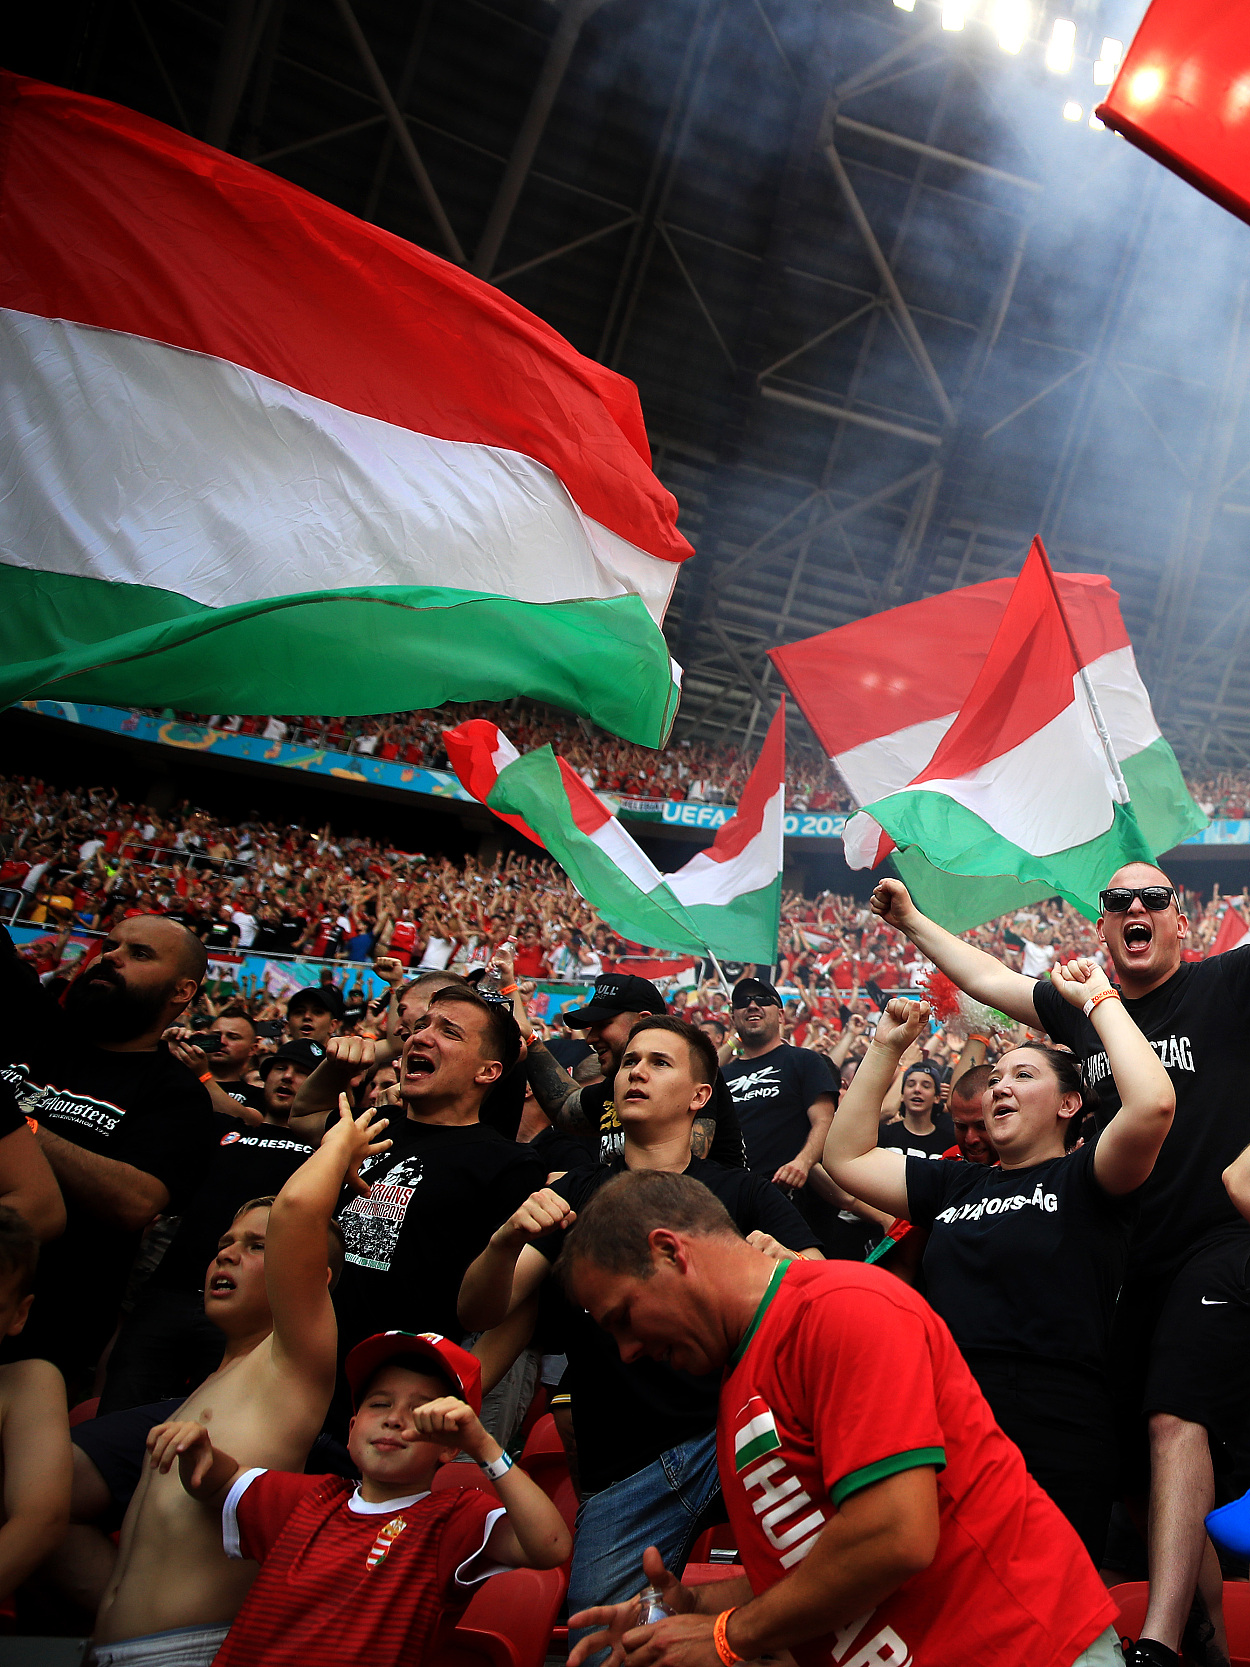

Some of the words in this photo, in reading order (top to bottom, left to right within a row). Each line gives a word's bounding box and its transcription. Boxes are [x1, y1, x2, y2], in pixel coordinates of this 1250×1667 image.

[662, 802, 724, 827] UEFA
[597, 984, 617, 996] ULL
[238, 1137, 259, 1146] NO
[258, 1139, 313, 1153] RESPEC
